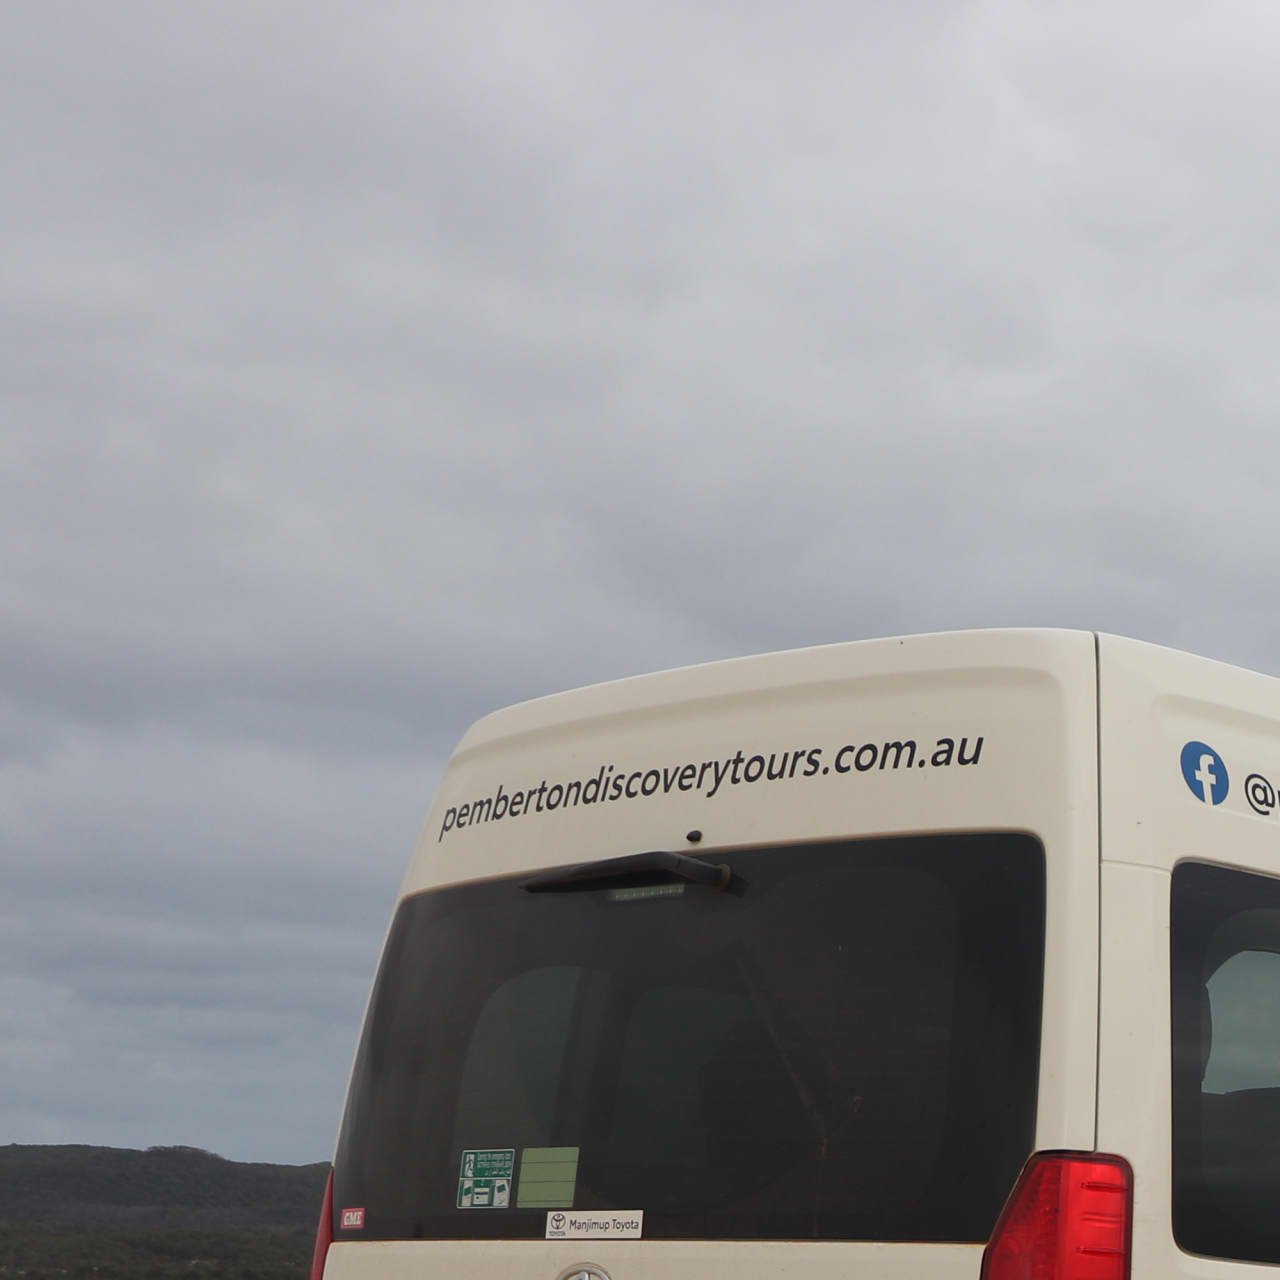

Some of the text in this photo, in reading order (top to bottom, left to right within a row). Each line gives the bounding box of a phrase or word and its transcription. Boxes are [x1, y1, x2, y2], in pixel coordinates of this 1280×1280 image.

[439, 735, 984, 841] pembertondiscoverytours.com.au
[569, 1218, 640, 1232] Manjimup Toyota
